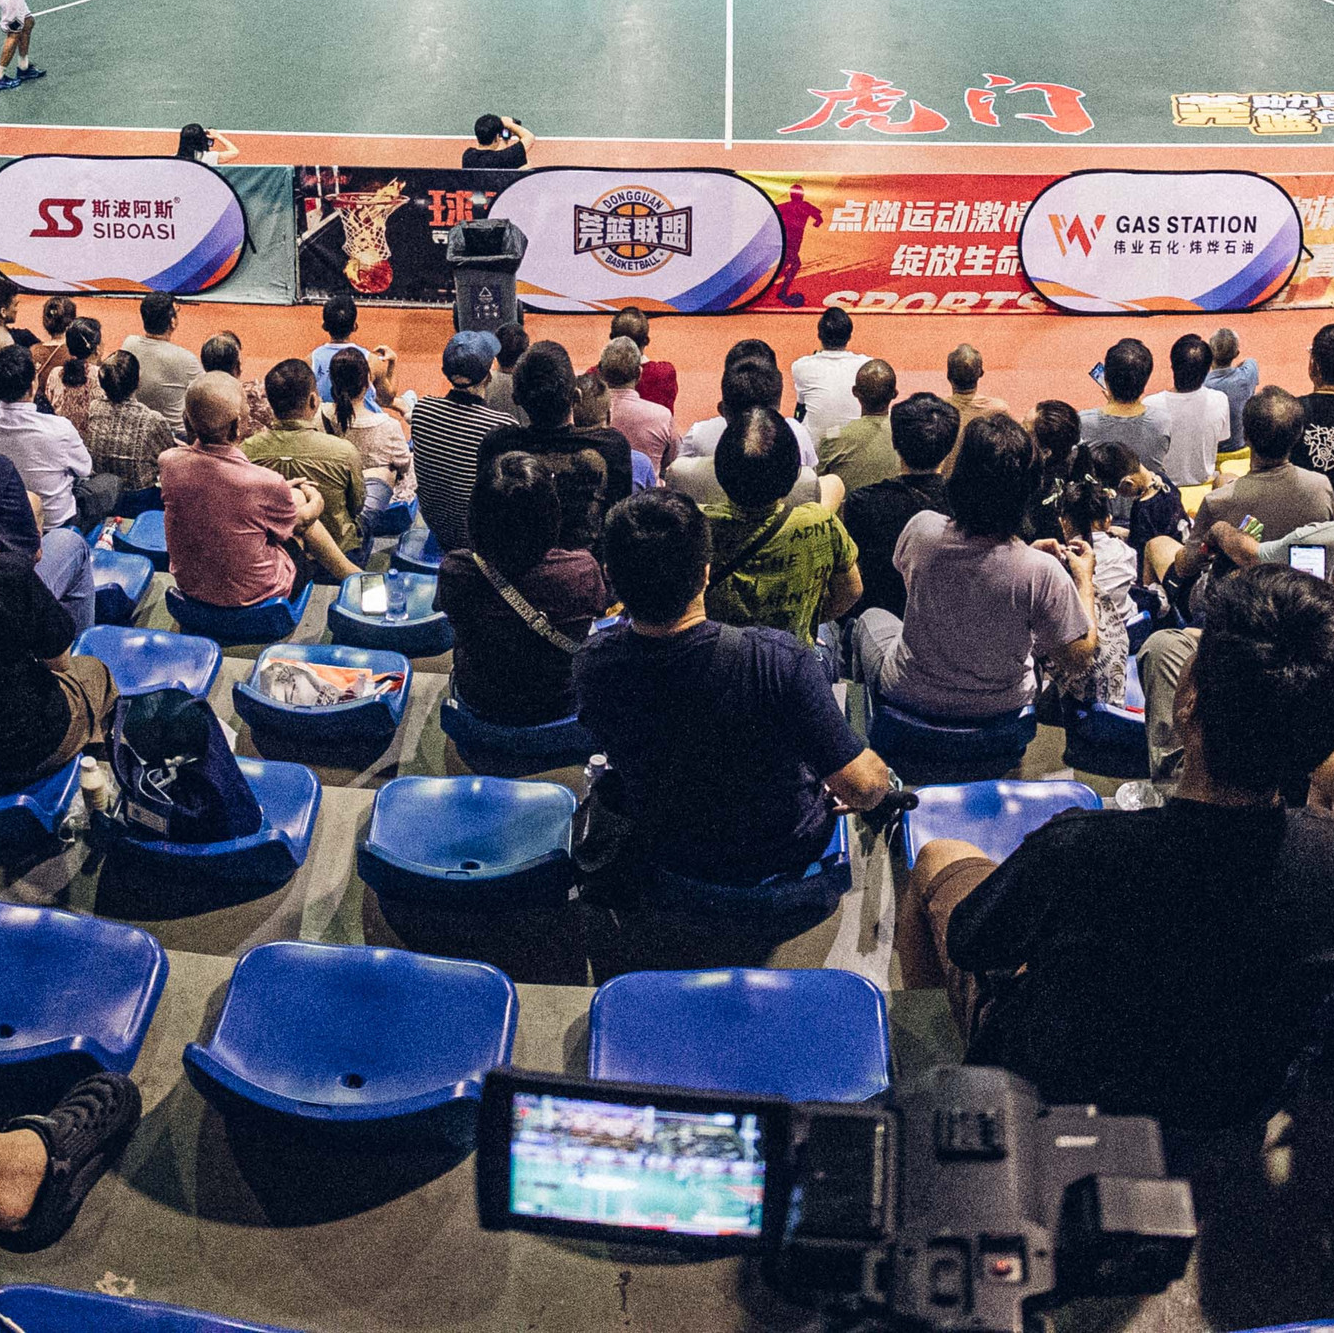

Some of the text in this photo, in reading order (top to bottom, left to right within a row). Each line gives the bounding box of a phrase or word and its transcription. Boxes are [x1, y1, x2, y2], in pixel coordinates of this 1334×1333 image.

[602, 190, 665, 210] DONGGUAN
[93, 223, 176, 240] SIBOASI
[578, 211, 687, 249] 莞篮联盟
[1116, 215, 1257, 234] GAS STATION
[1114, 240, 1255, 255] 伟业石化·炜烨石油
[605, 253, 661, 271] BASKETBALL
